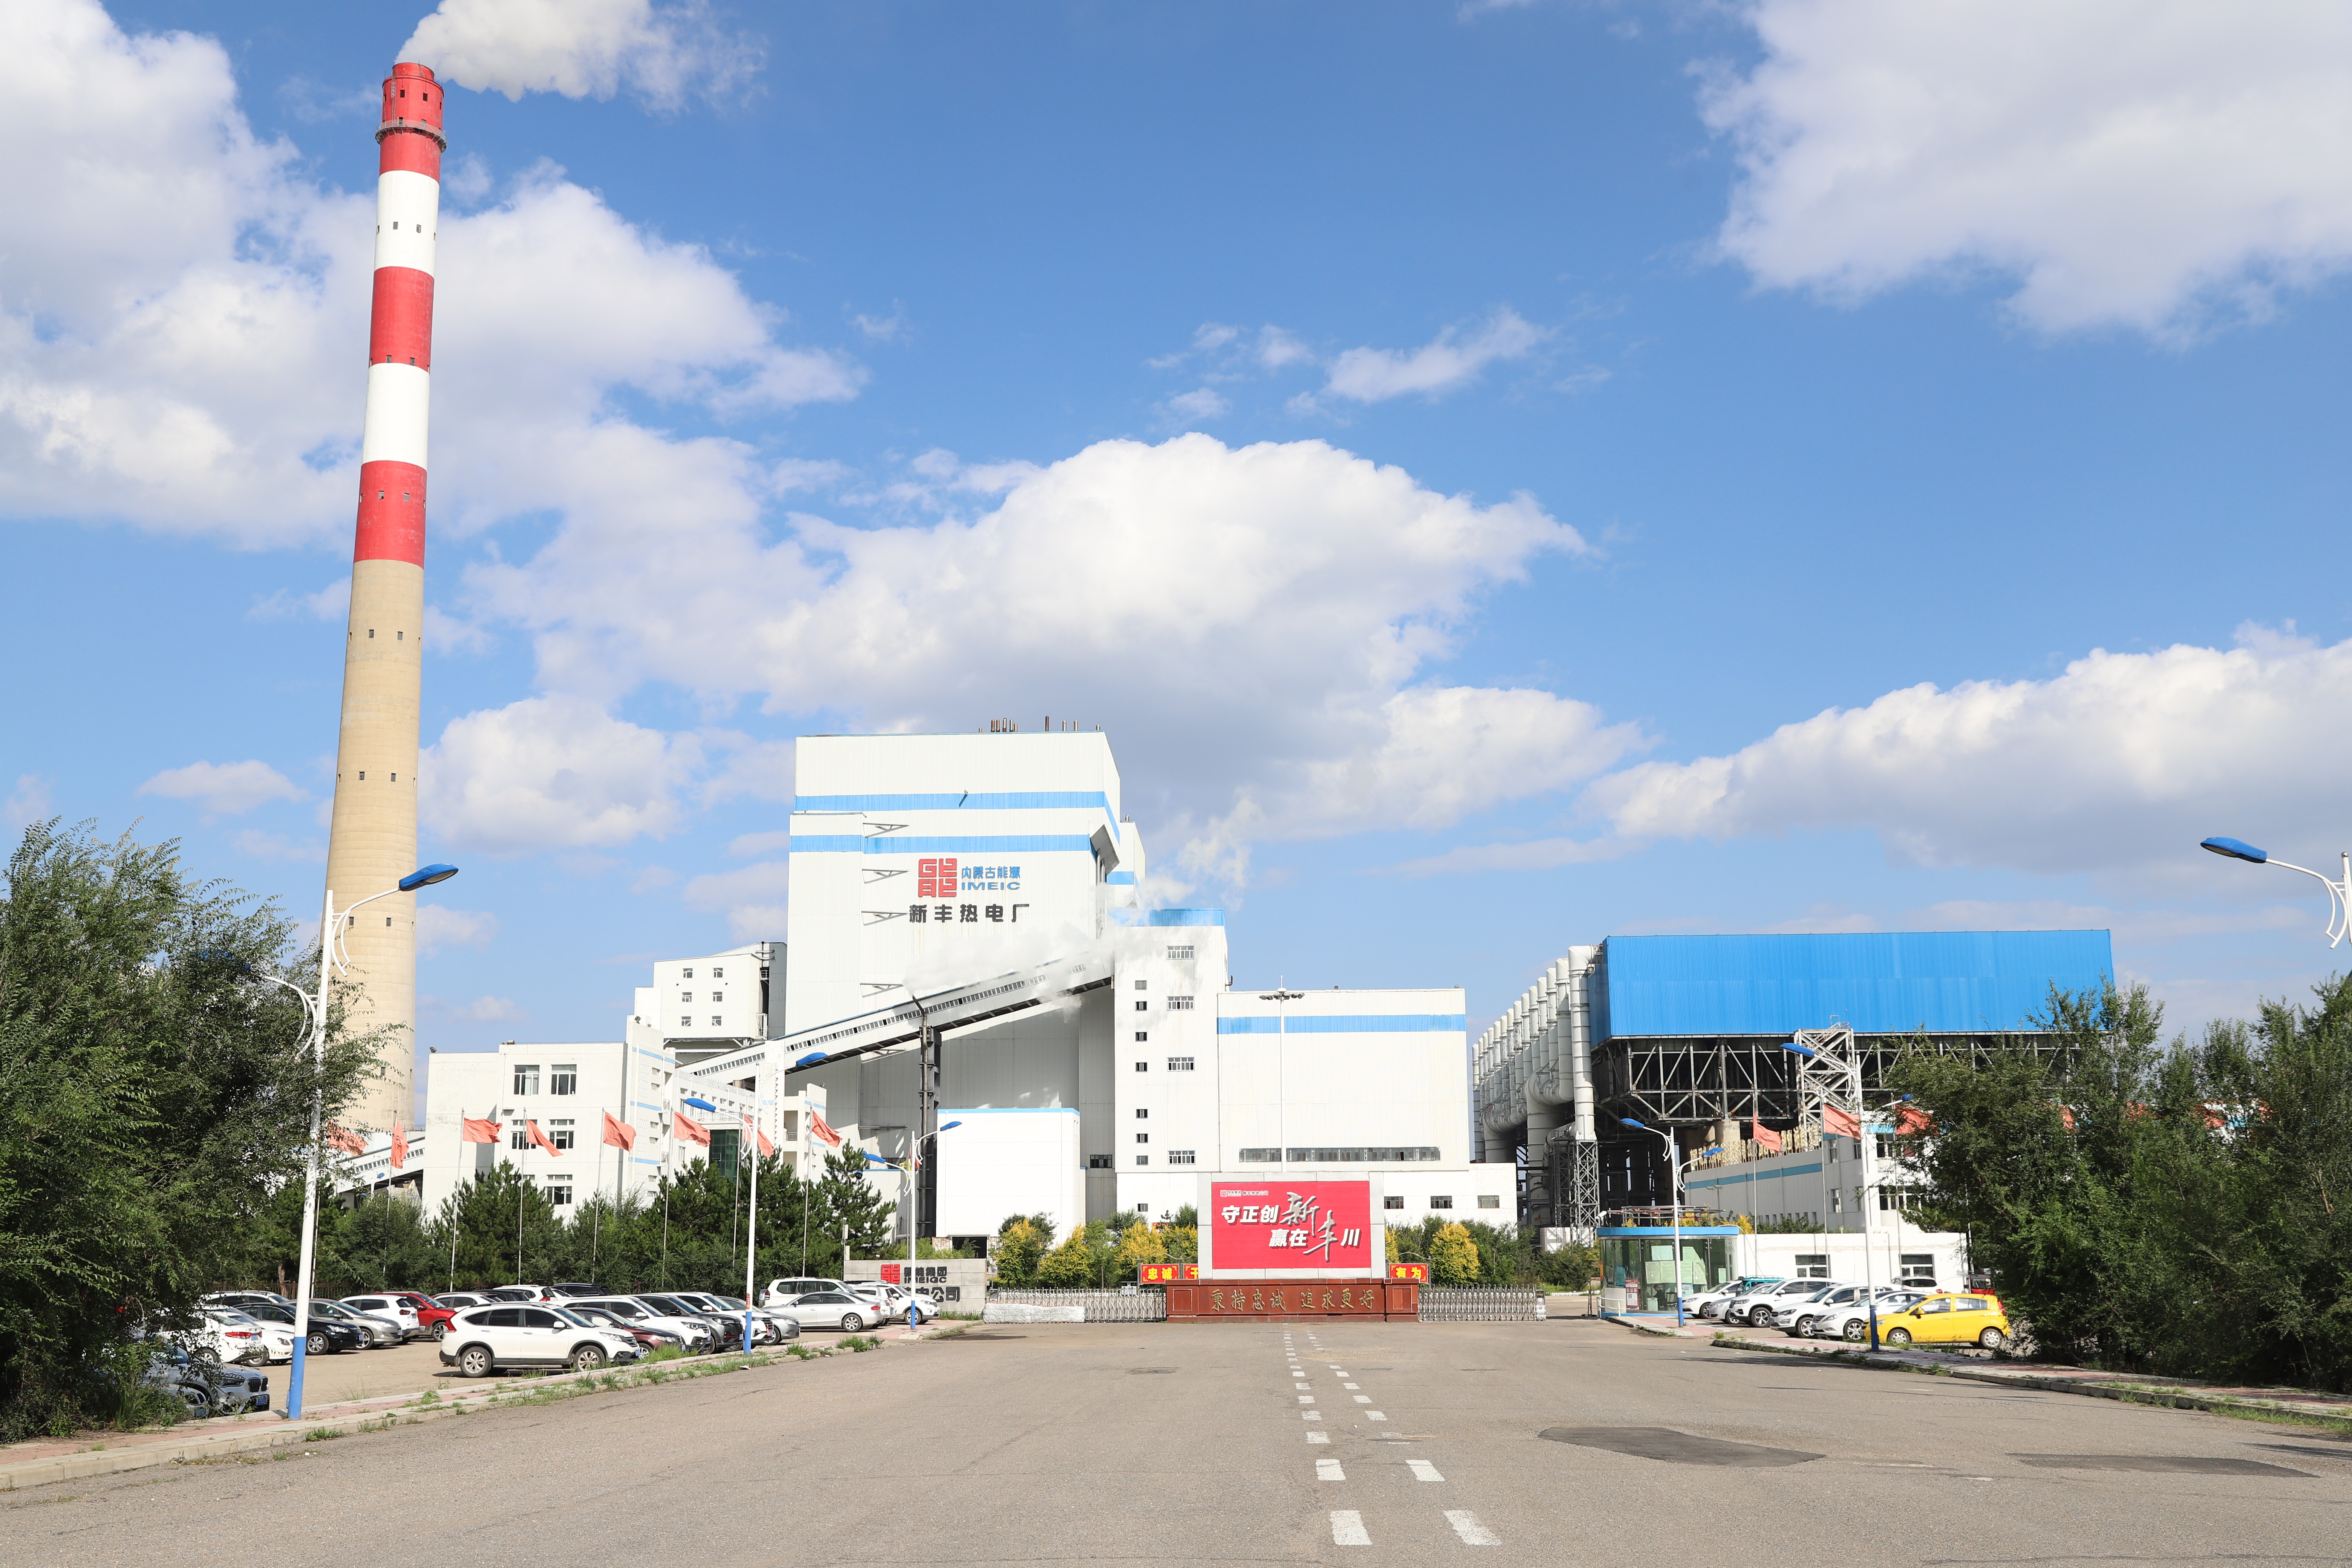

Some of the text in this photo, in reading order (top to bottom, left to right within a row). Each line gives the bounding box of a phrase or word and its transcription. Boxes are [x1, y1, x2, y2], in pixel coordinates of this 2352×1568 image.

[962, 866, 1020, 879] 内蒙古能源
[962, 882, 1020, 890] IMEIC
[910, 904, 1029, 923] 新丰热电厂
[1148, 1268, 1172, 1280] 忠诚
[1396, 1267, 1421, 1278] 有为
[1211, 1287, 1375, 1312] 秉持忠诚 追求更好
